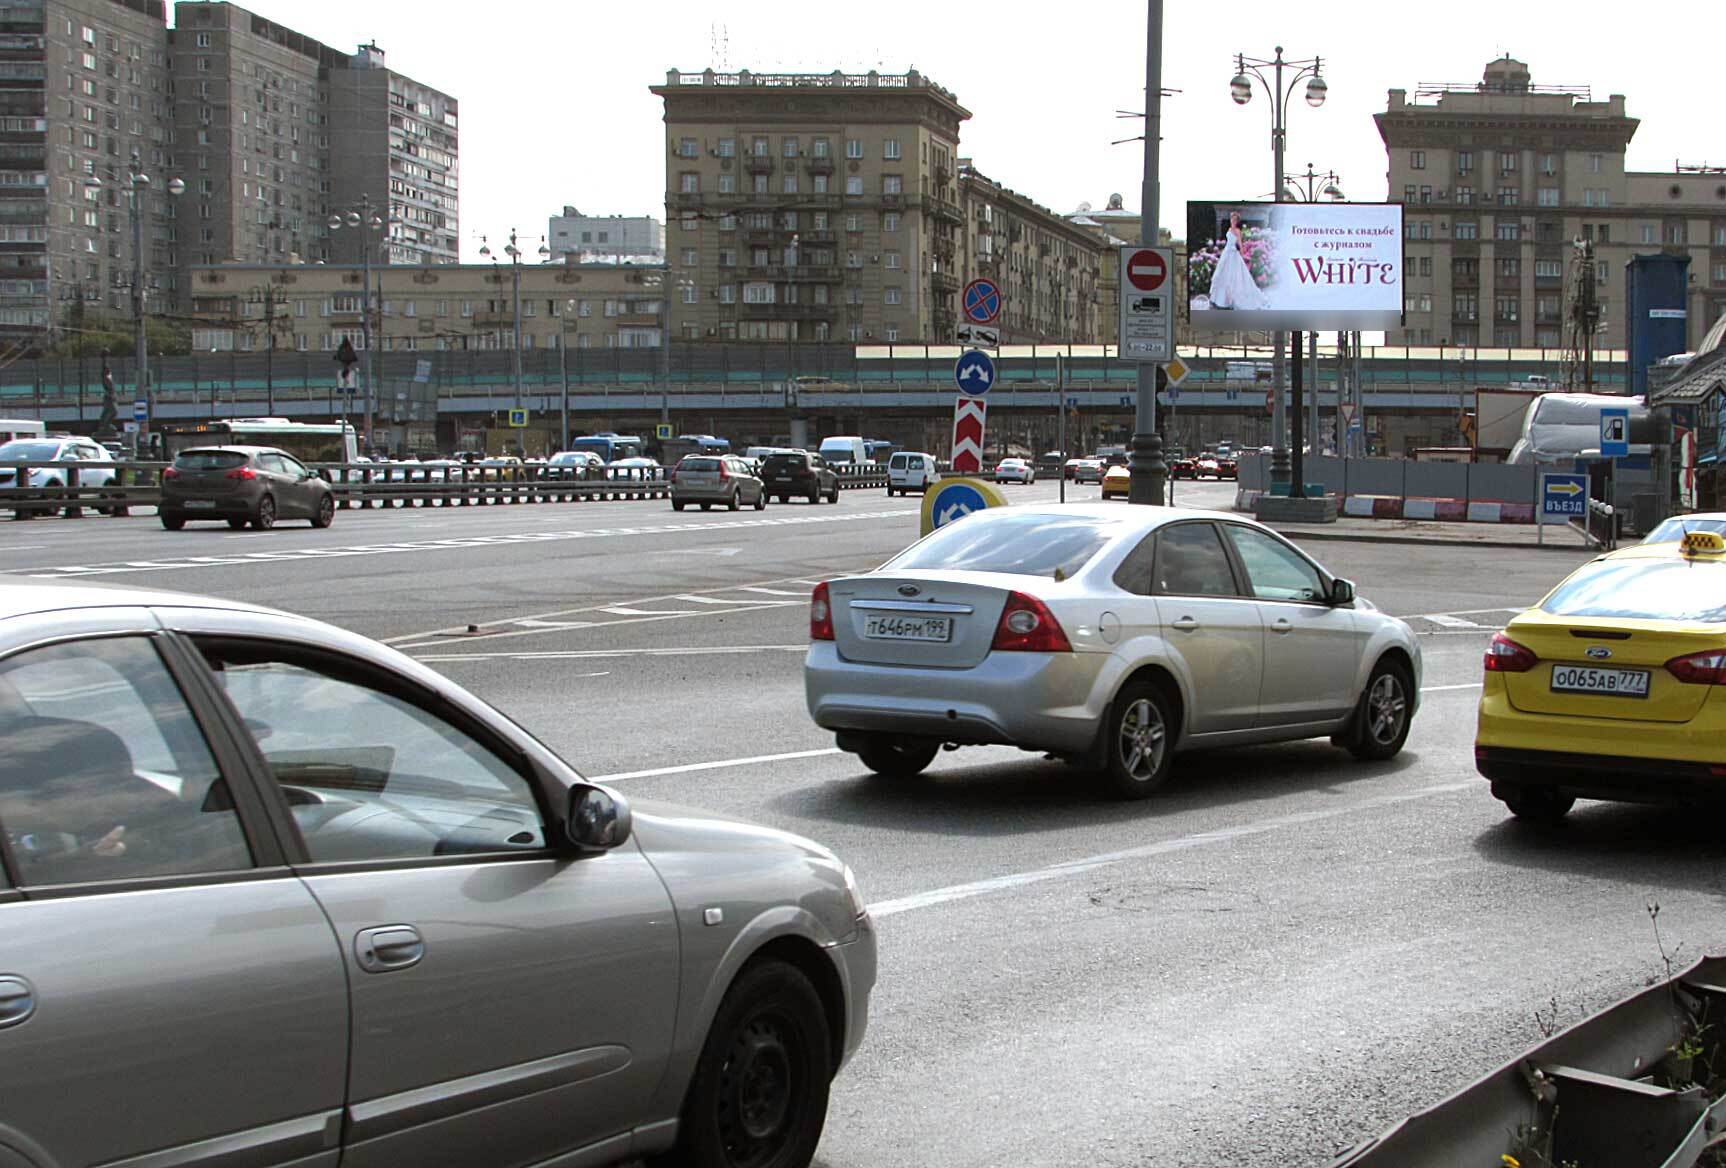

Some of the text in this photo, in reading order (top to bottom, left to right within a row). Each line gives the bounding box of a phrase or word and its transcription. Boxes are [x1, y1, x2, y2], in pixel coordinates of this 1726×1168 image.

[1291, 225, 1345, 236] Готовьтесь
[1355, 225, 1395, 236] свадьбе
[1321, 241, 1372, 251] журналом
[1291, 255, 1396, 284] WHITE
[1546, 500, 1583, 513] ВЪЕЗД
